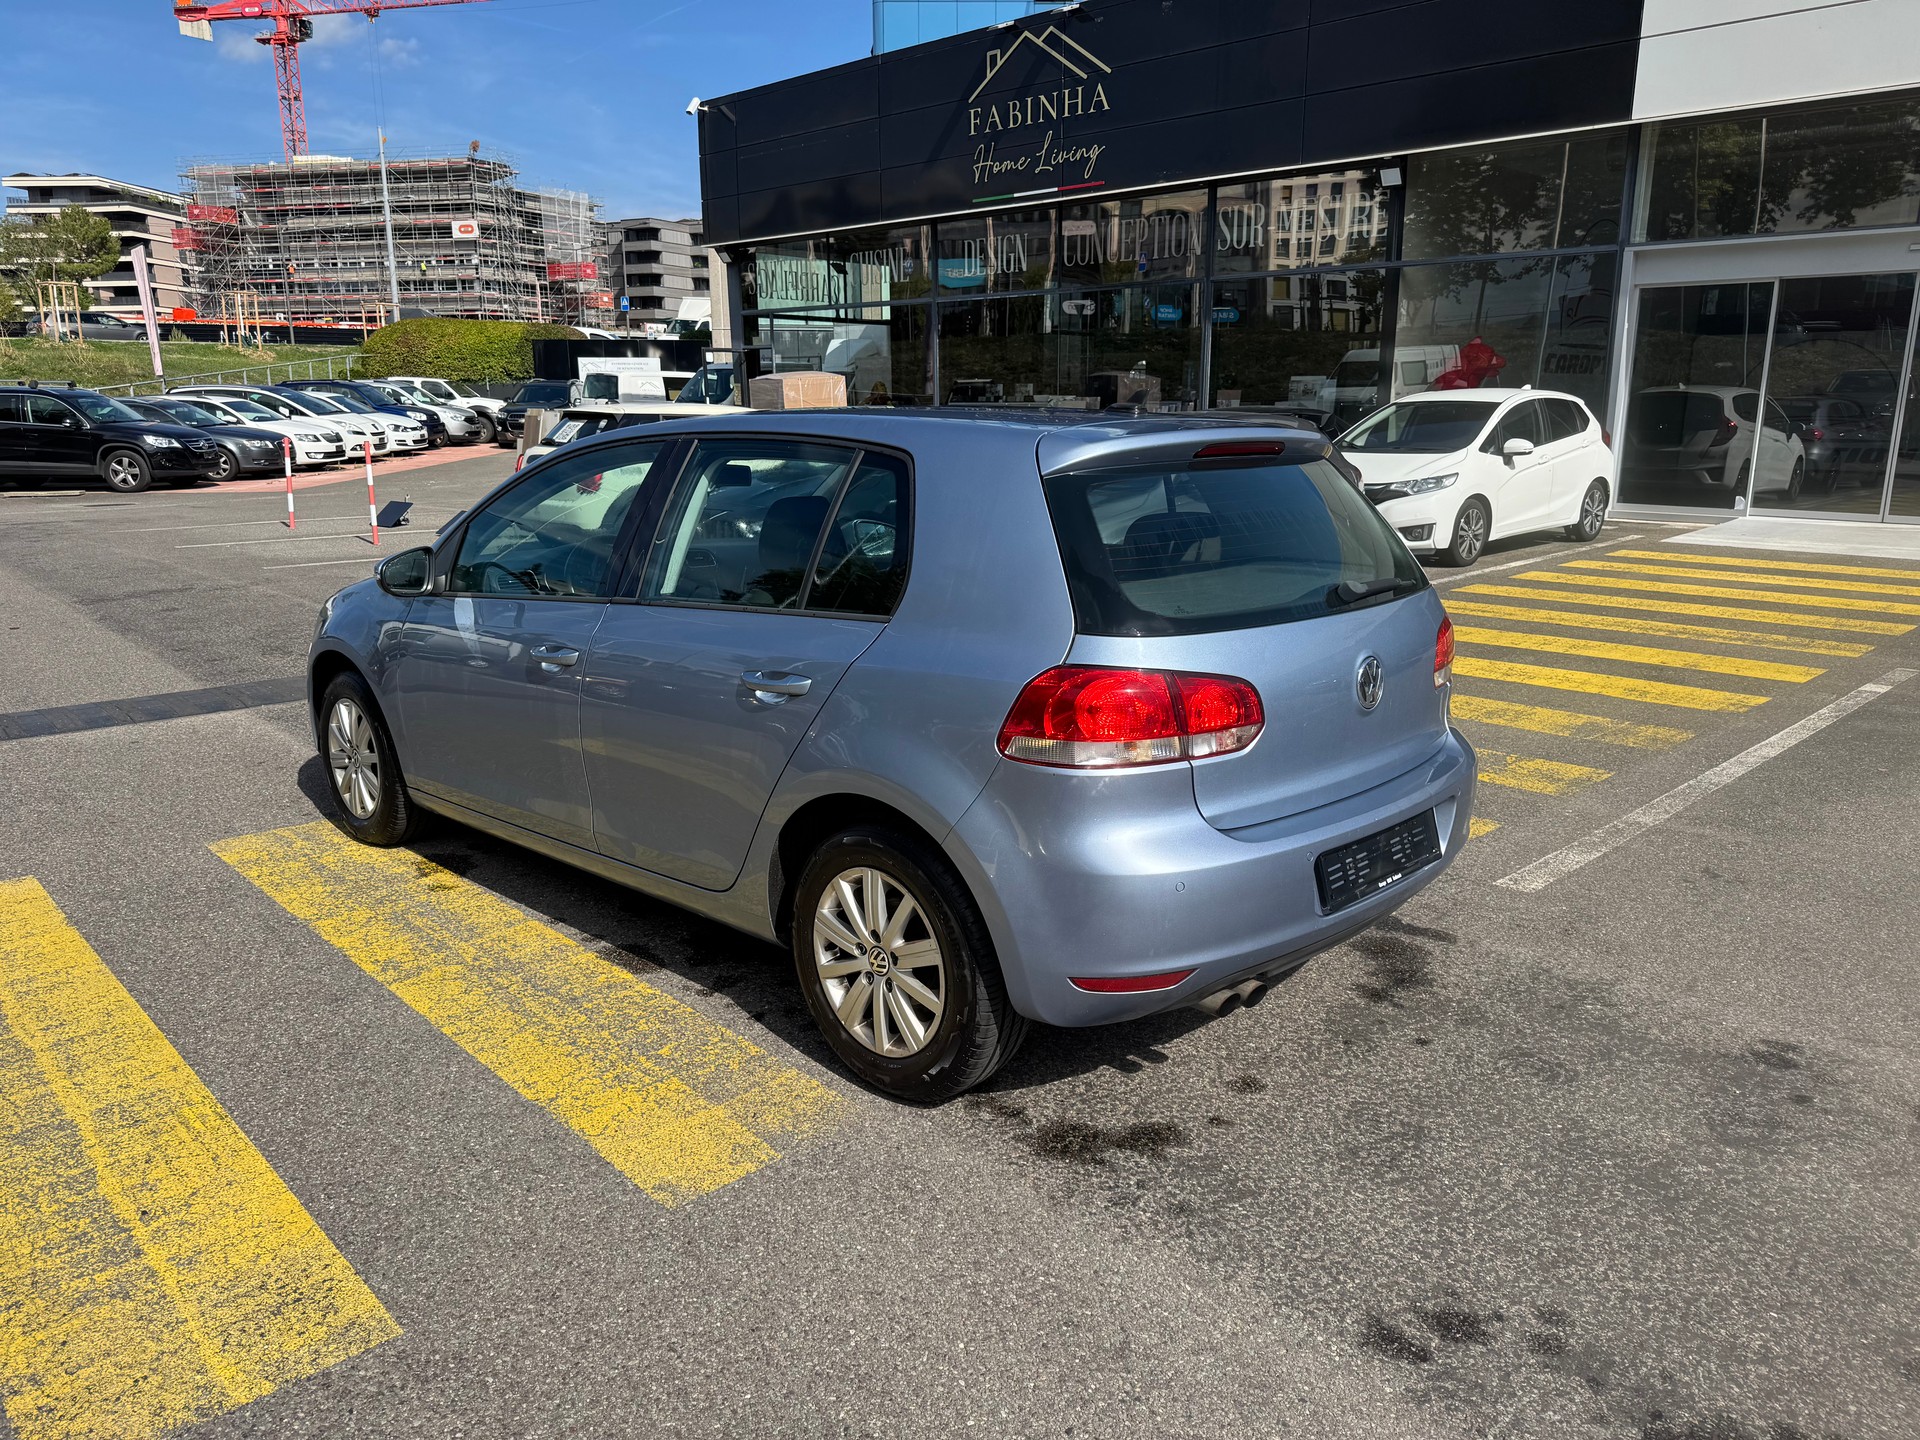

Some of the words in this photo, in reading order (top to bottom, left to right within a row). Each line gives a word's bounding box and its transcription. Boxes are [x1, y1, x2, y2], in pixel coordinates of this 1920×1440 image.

[968, 82, 1111, 136] FABINHA
[973, 142, 1031, 184] Home
[1034, 130, 1106, 180] Living
[1062, 211, 1205, 267] CONCEPTION
[1217, 190, 1391, 251] SUR-MESURE
[850, 247, 910, 287] CUISINE
[964, 233, 1029, 277] DESIGN
